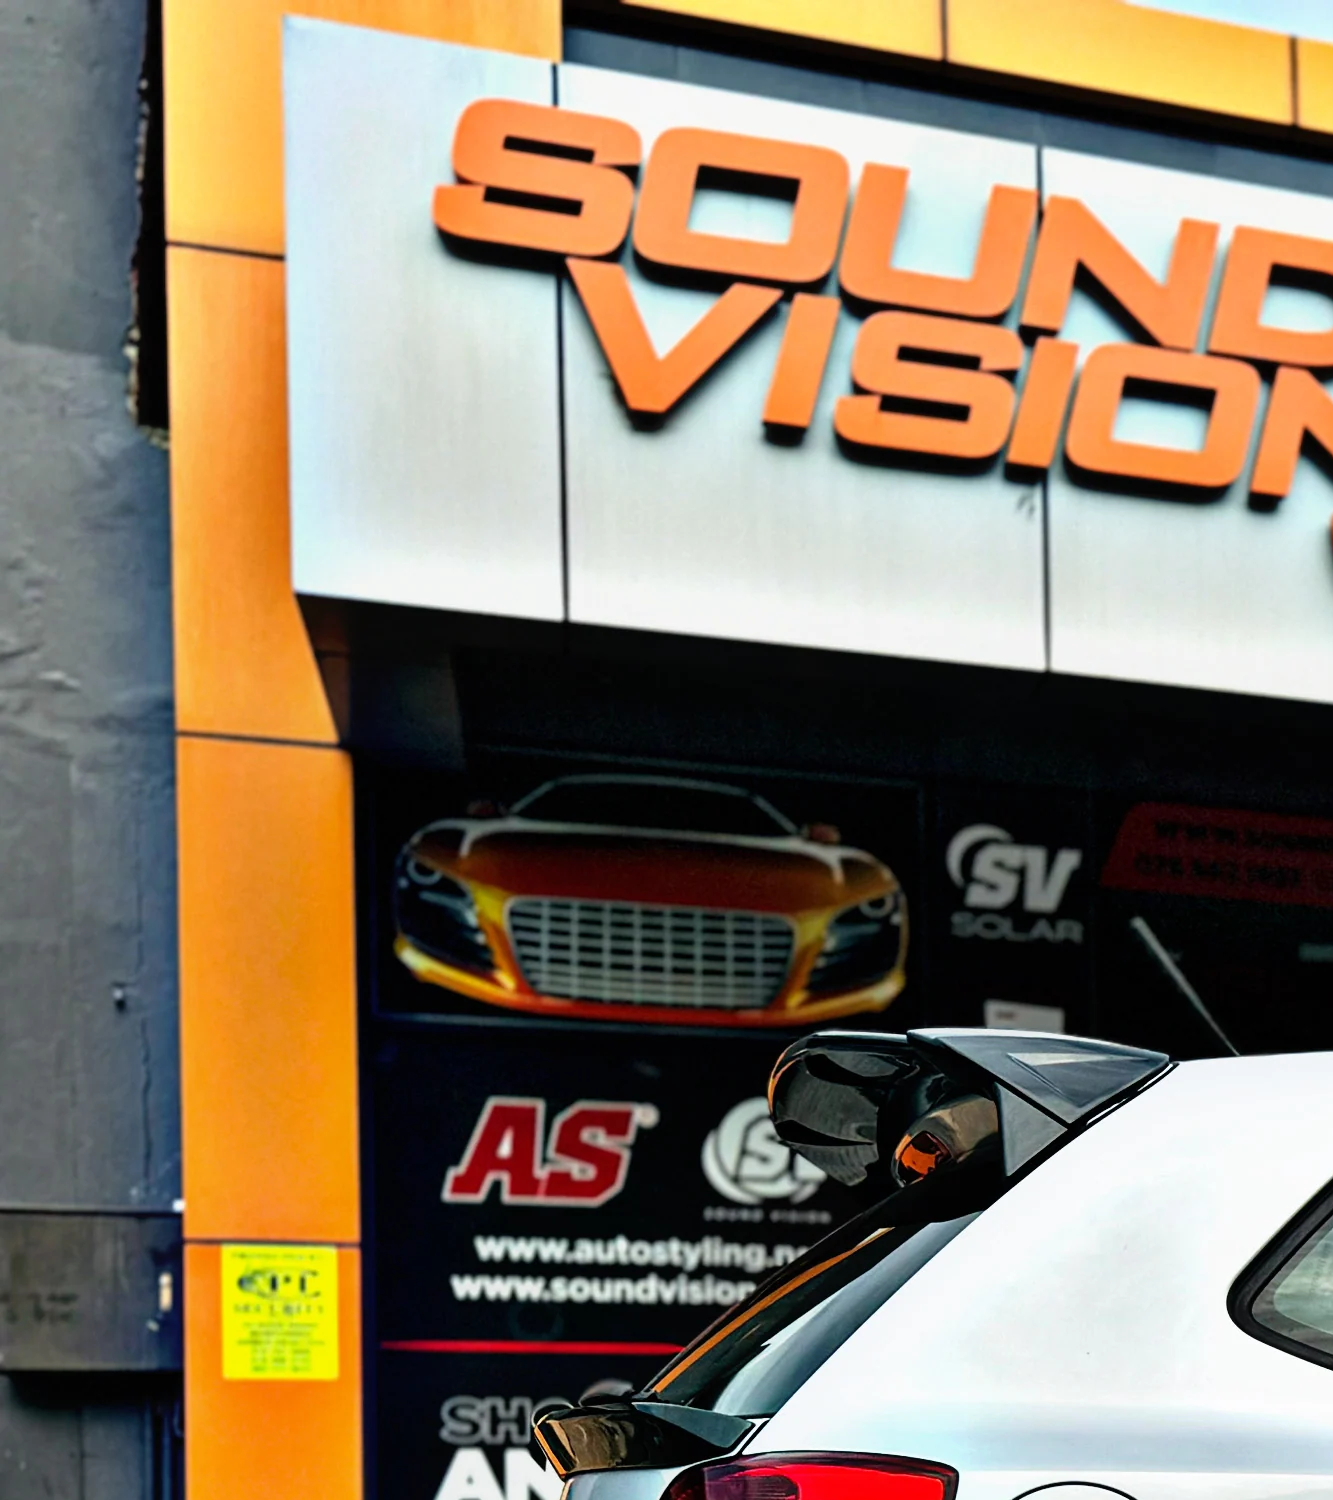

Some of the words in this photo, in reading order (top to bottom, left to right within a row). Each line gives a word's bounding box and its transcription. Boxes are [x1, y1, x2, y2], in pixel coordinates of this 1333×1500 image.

[964, 842, 1082, 913] SV
[951, 911, 1084, 943] SOLAR
[441, 1095, 640, 1208] AS
